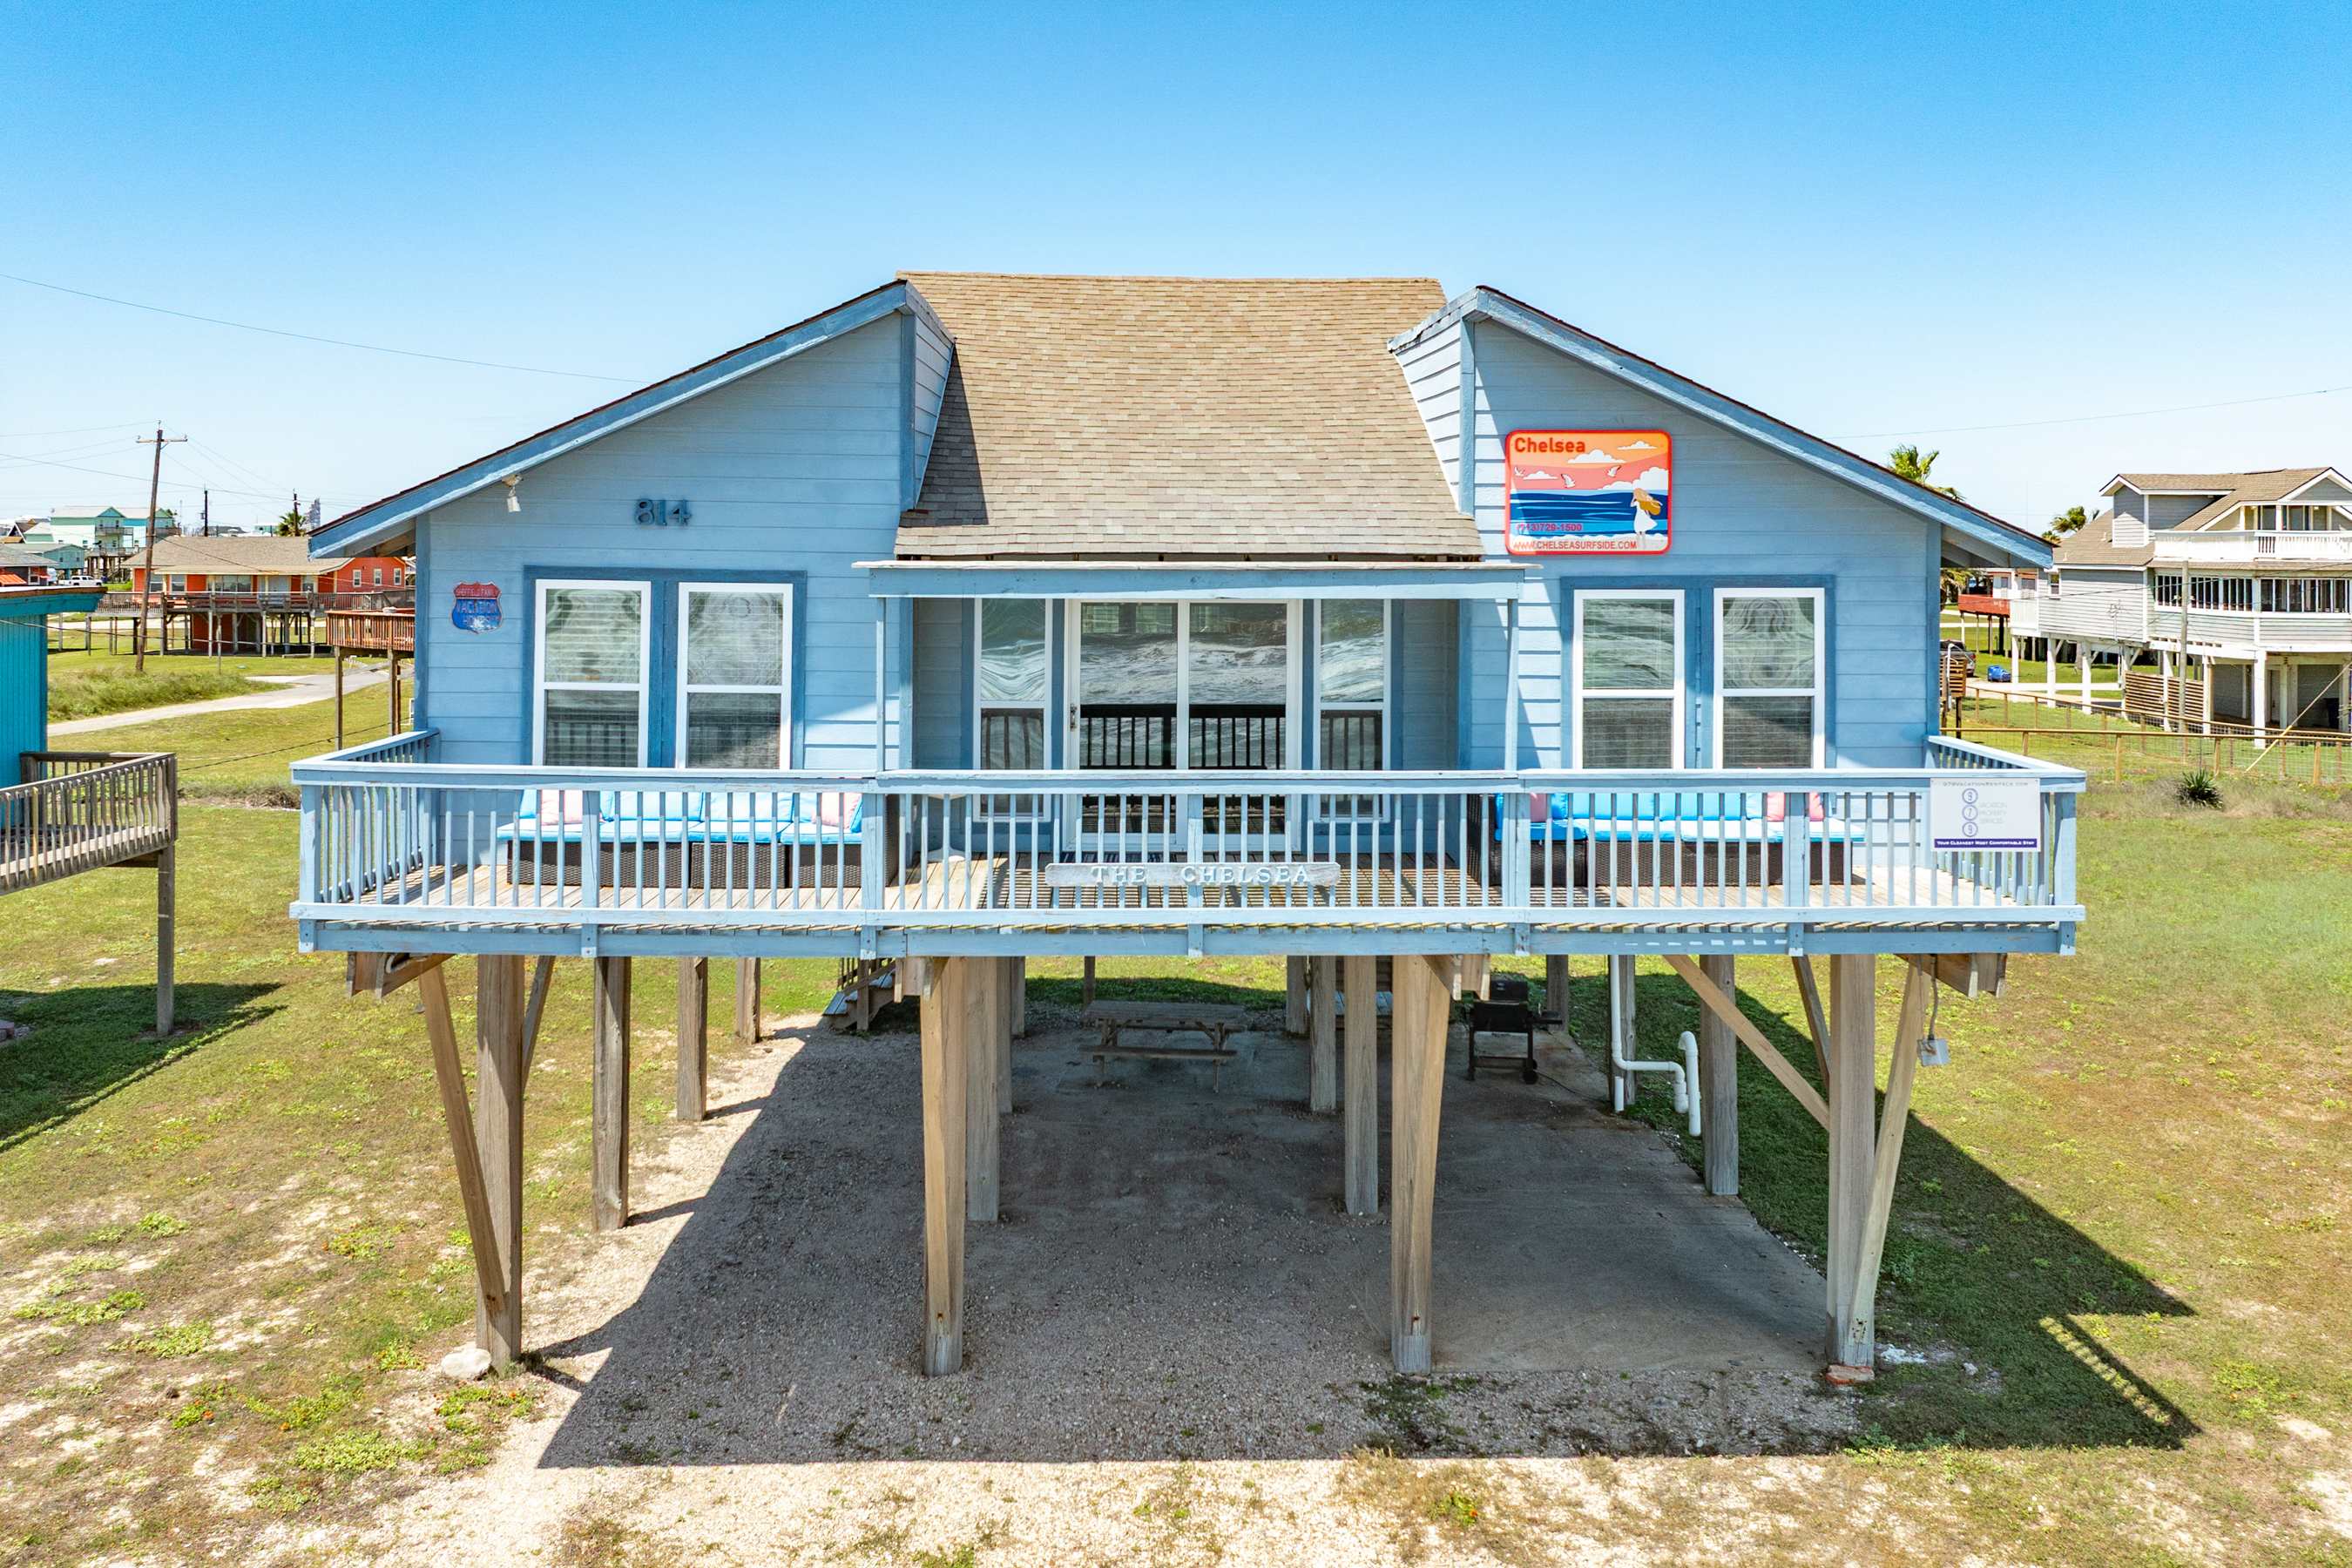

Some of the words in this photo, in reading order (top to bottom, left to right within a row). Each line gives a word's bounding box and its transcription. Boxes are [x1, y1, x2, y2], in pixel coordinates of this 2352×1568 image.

[1514, 437, 1585, 453] Chelsea
[634, 498, 693, 526] 814
[1091, 865, 1147, 884] THE
[1180, 864, 1311, 885] CHELSEA
